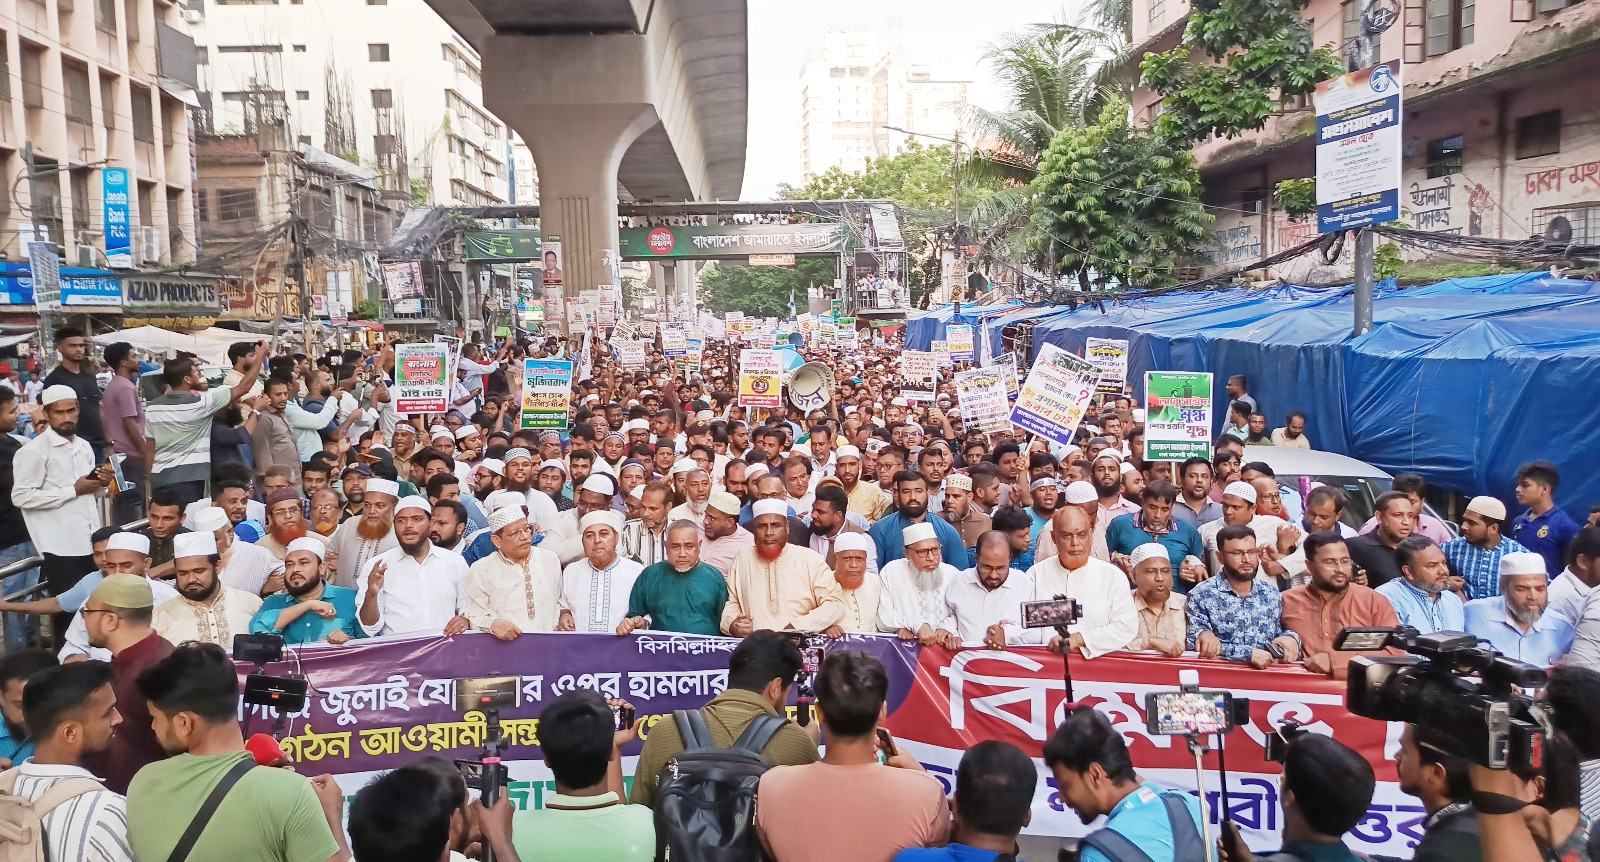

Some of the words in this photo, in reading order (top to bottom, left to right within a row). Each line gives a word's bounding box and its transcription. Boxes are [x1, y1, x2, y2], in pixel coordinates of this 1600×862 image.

[1409, 176, 1456, 206] ইসলামী
[1525, 168, 1564, 196] ঢাকা
[105, 190, 127, 204] Janata
[108, 207, 125, 223] Bank
[692, 234, 740, 250] বাংলাদেশ
[743, 233, 791, 248] জামায়াতে
[792, 229, 832, 245] ইসলামী
[127, 281, 157, 302] AZAD
[160, 283, 215, 302] PRODUCTS
[527, 375, 570, 388] মুজিববাদ
[1180, 408, 1207, 424] মুগ্ধ
[1186, 425, 1208, 438] যুদ্ধ
[320, 674, 411, 726] জুলাই
[629, 668, 730, 701] হামলার
[280, 724, 352, 763] গঠন
[360, 711, 488, 756] আওয়ামী
